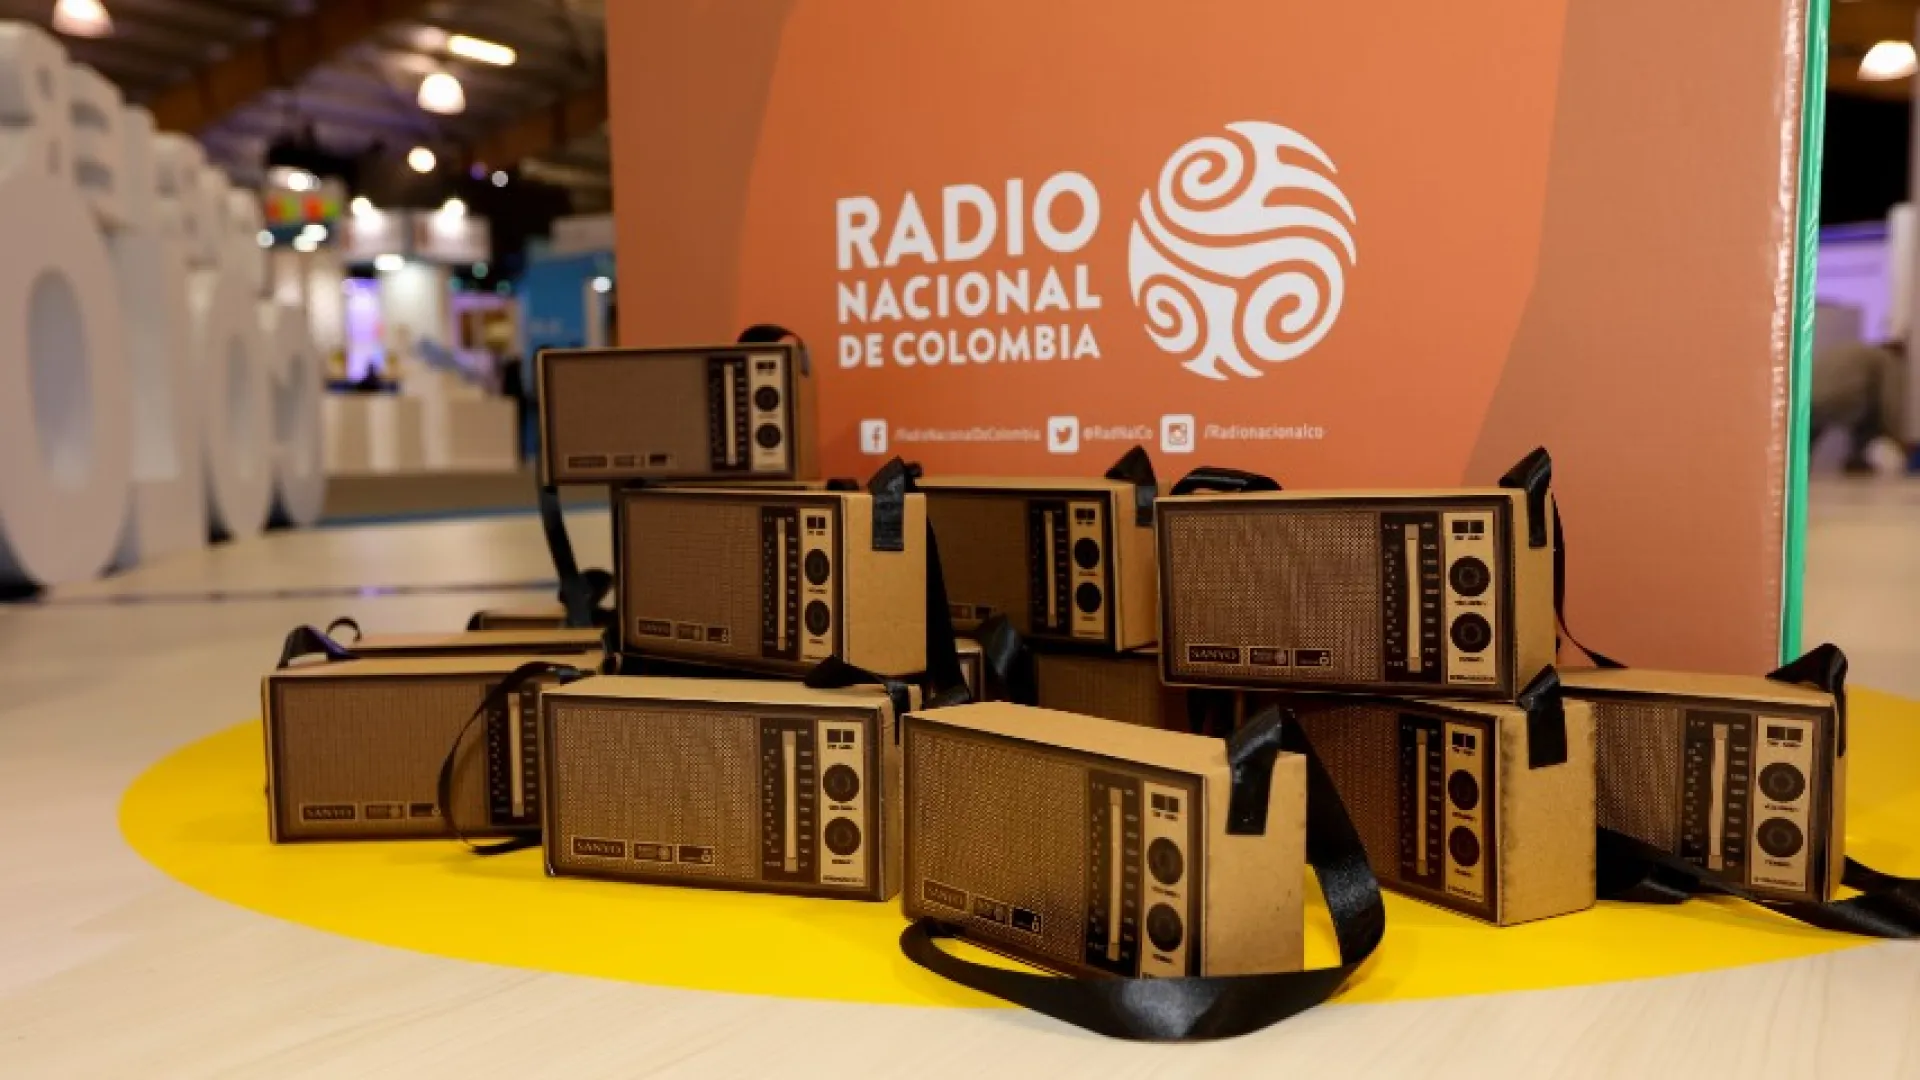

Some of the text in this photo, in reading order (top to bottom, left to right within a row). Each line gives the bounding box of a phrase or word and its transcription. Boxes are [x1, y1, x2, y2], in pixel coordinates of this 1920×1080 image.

[836, 171, 1101, 270] RADIO
[837, 263, 1102, 323] NACIONAL
[839, 323, 1101, 368] DE COLOMBIA
